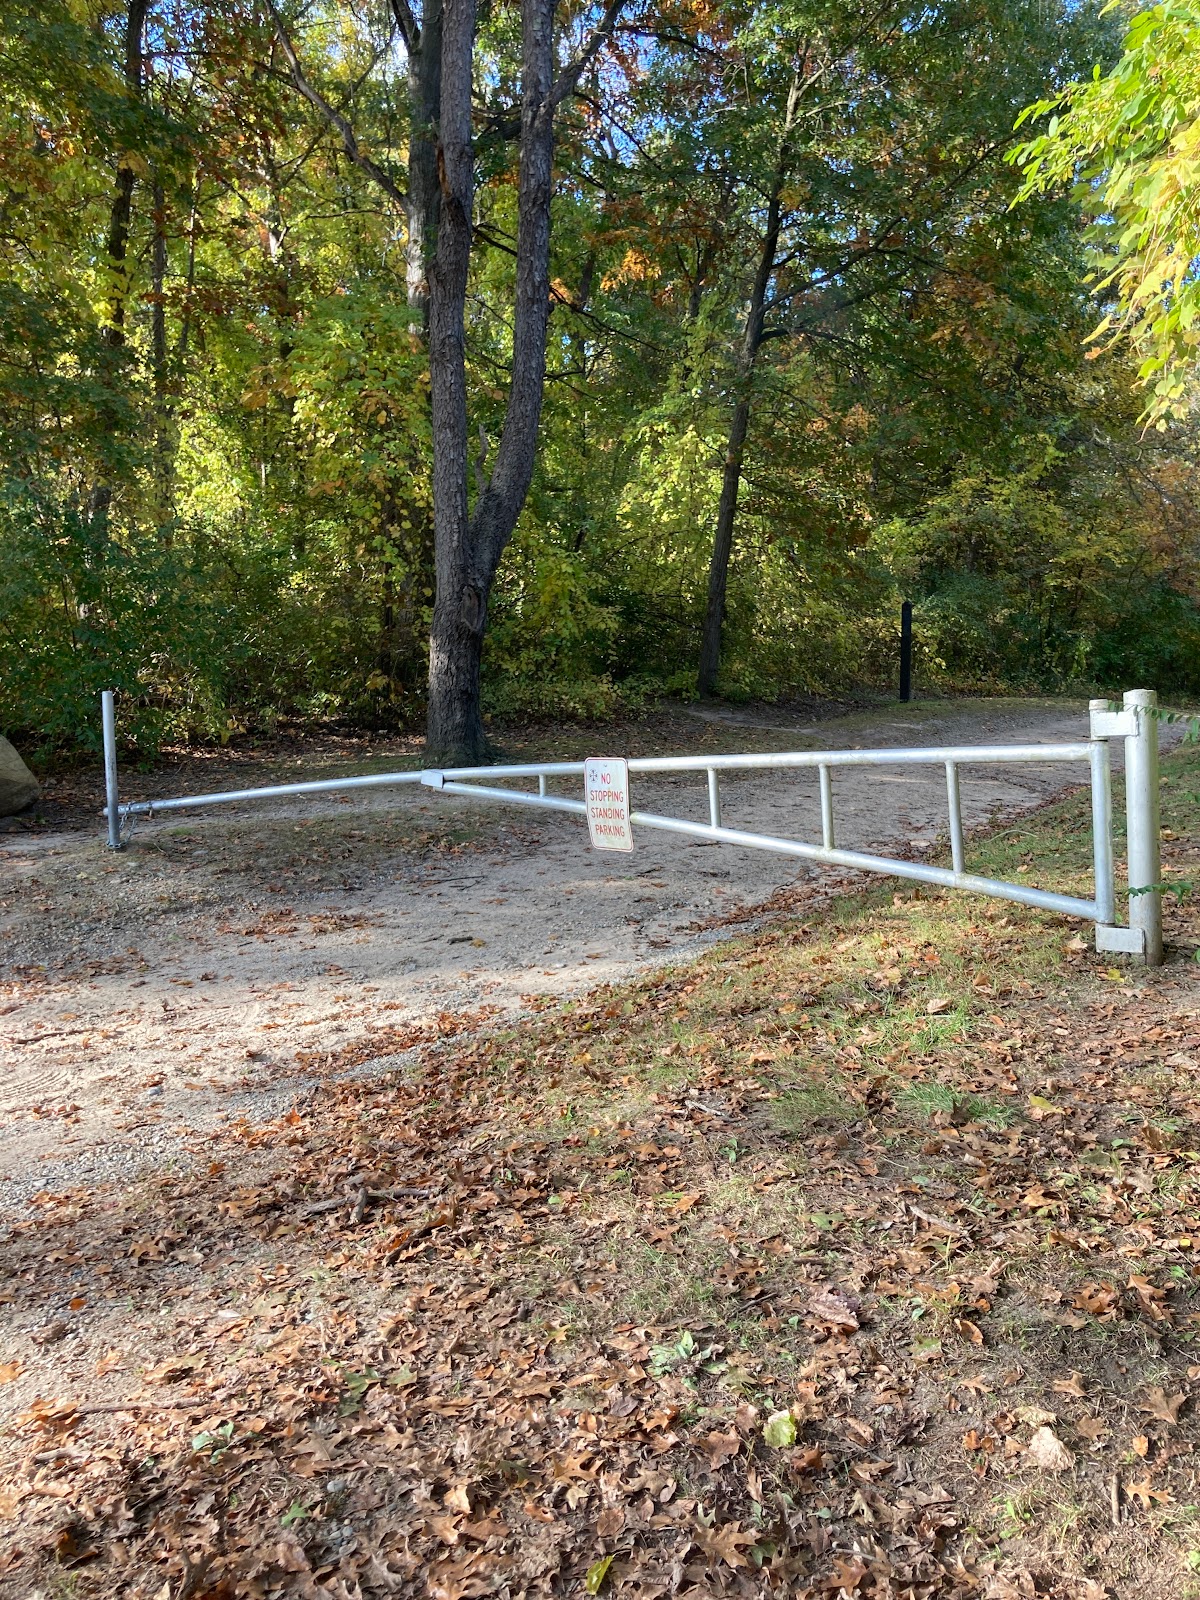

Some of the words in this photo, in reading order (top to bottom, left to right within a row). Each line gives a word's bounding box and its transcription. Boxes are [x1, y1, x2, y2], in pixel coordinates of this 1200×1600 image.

[601, 773, 611, 784] NO
[590, 790, 623, 803] STOPPING
[591, 807, 625, 820] STANDING
[595, 824, 625, 837] PARKING
